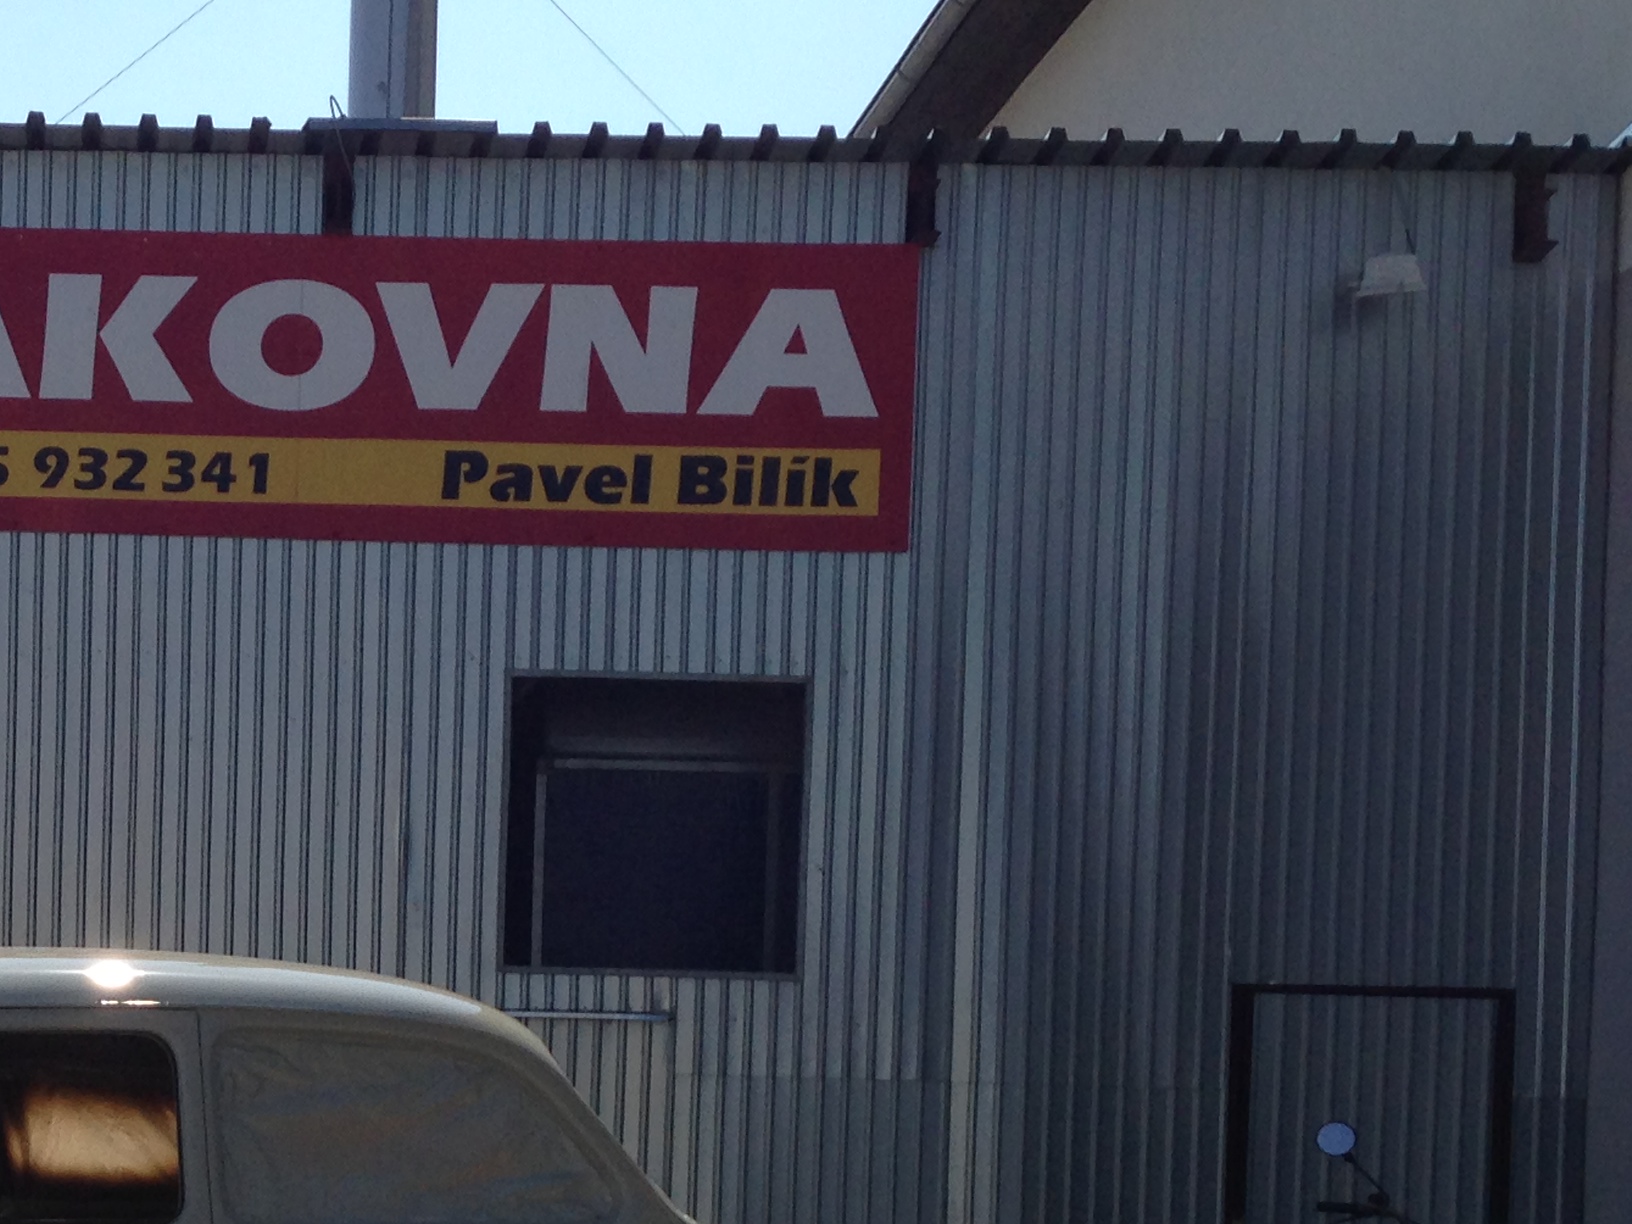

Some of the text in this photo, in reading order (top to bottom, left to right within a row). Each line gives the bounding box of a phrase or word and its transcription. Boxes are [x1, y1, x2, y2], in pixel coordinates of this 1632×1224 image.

[32, 446, 149, 492] 932
[160, 449, 271, 495] 341
[440, 449, 860, 507] Pavel Bilík
